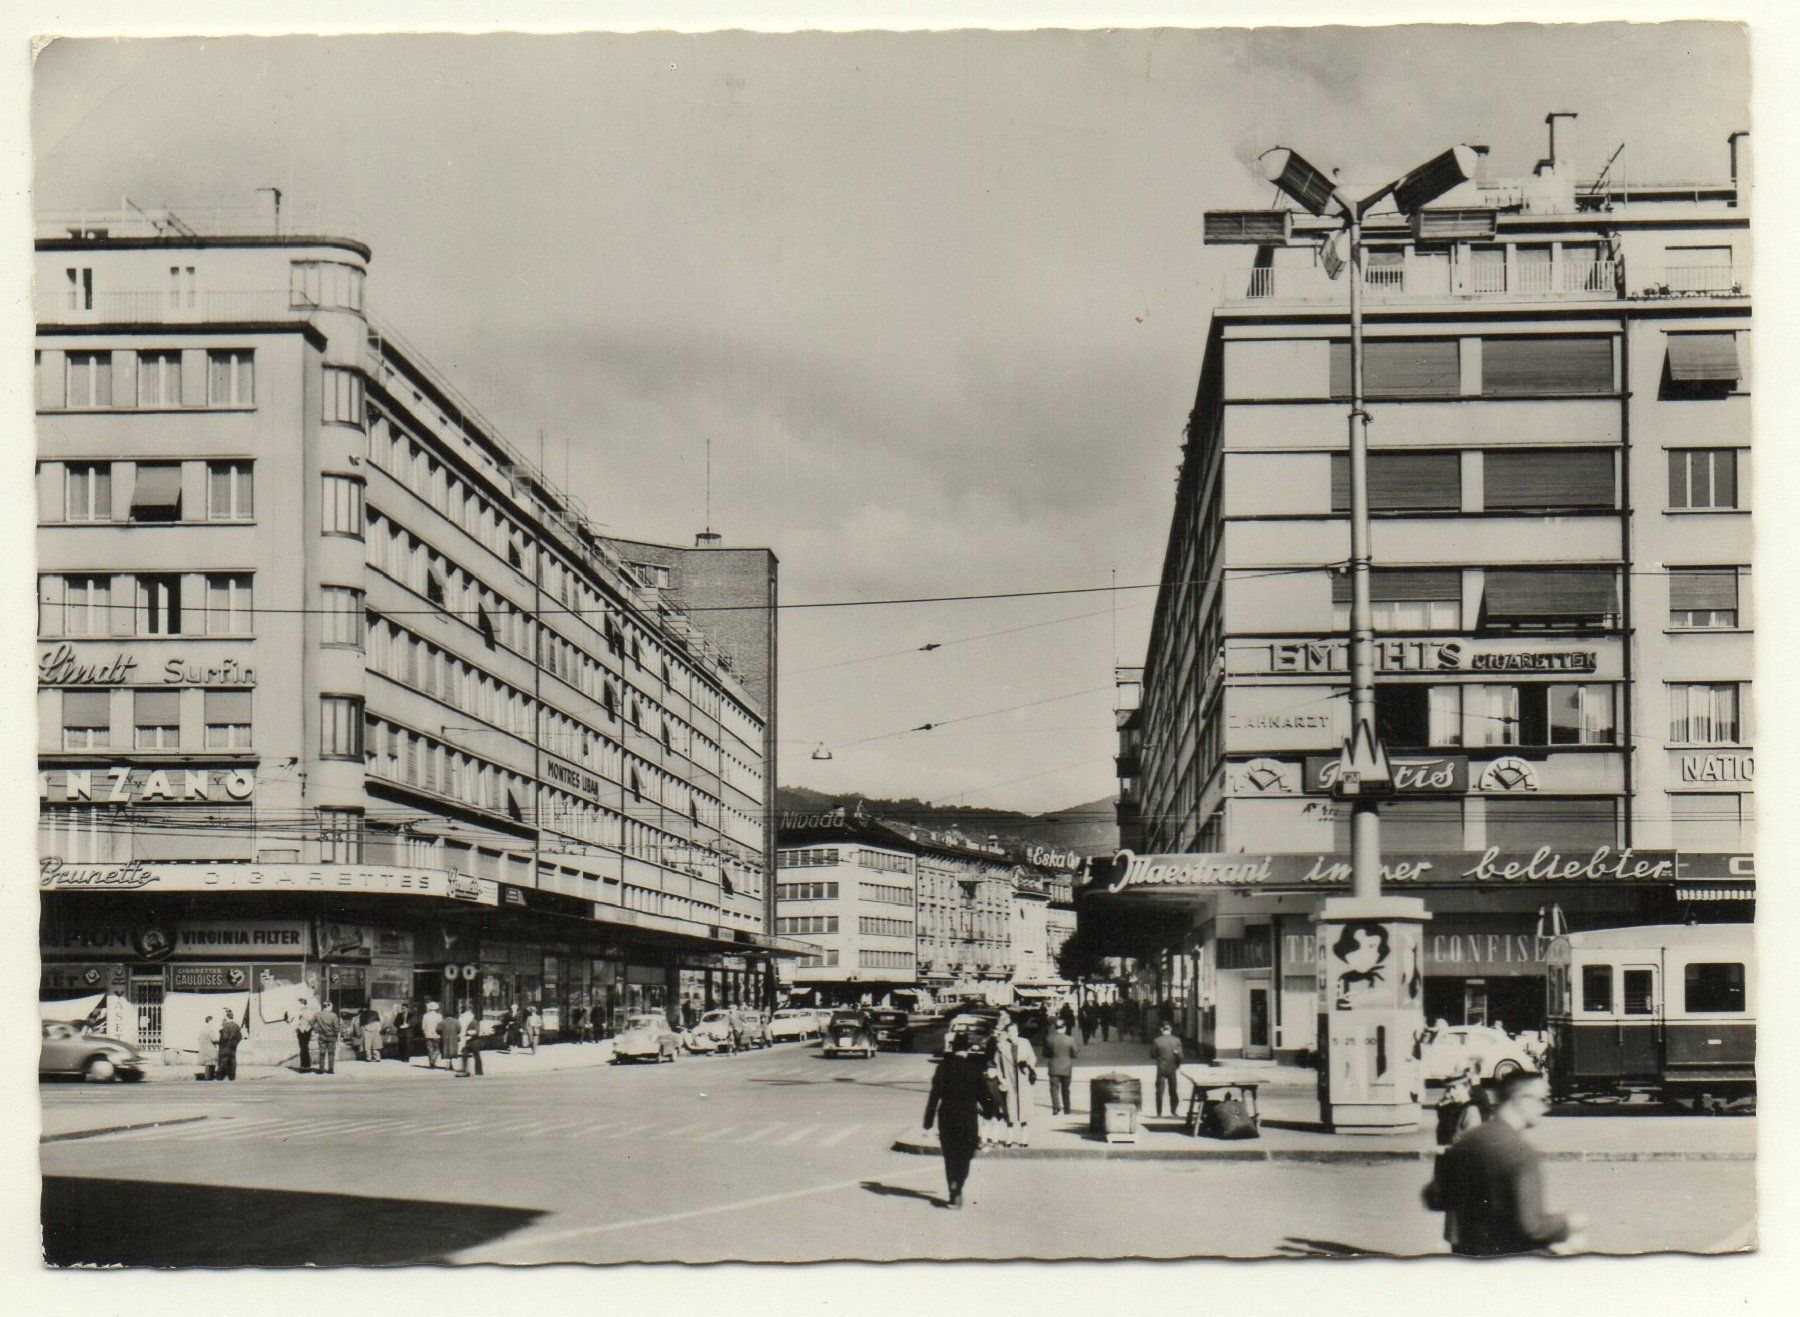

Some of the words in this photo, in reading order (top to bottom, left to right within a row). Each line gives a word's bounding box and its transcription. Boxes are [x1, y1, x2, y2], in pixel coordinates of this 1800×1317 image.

[38, 643, 137, 684] Lindt
[164, 659, 257, 684] Surfin
[548, 760, 579, 788] MONTRES
[780, 811, 845, 830] Nivada
[40, 856, 160, 890] Brunette
[1108, 848, 1272, 893] Maestrani
[1462, 846, 1672, 880] beliebter
[182, 930, 249, 945] VIRGINIA
[253, 930, 300, 945] FILTER
[175, 975, 223, 986] GAULOISES
